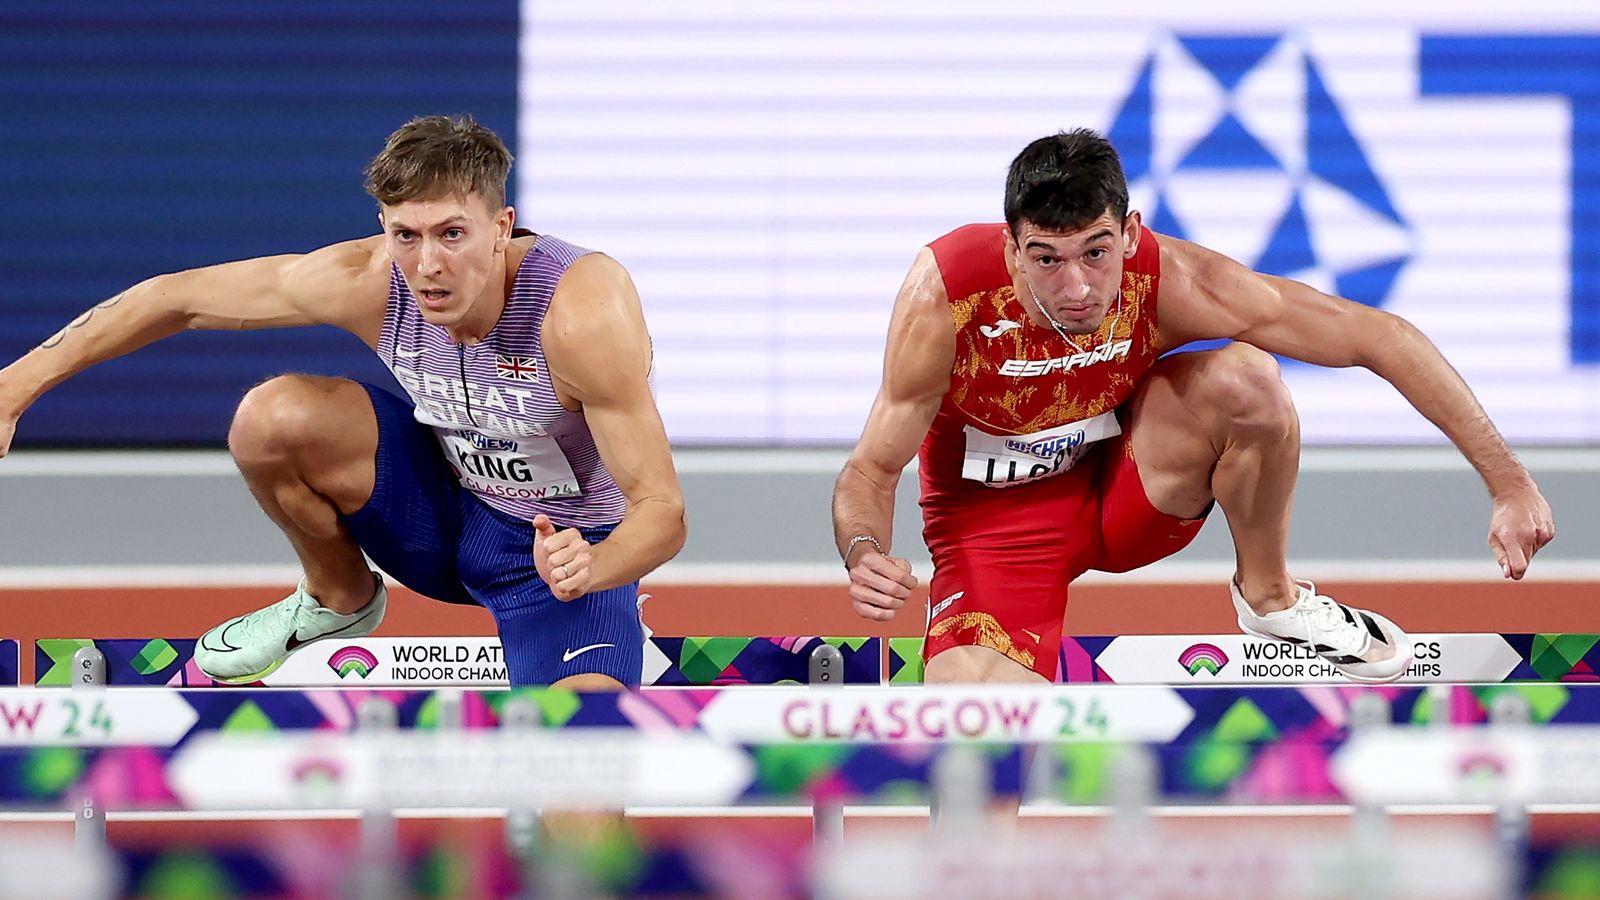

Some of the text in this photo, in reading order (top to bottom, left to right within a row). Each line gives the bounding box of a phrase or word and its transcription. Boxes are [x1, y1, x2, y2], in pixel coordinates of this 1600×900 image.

[392, 366, 533, 415] GREAT
[455, 445, 534, 483] KING
[466, 478, 573, 498] GLASGOW 24
[931, 591, 965, 619] ESP
[392, 646, 469, 662] WORLD
[392, 667, 454, 680] INDOOR
[1242, 664, 1304, 677] INDOOR
[61, 698, 113, 736] 24
[781, 697, 1108, 739] GLASGOW 24
